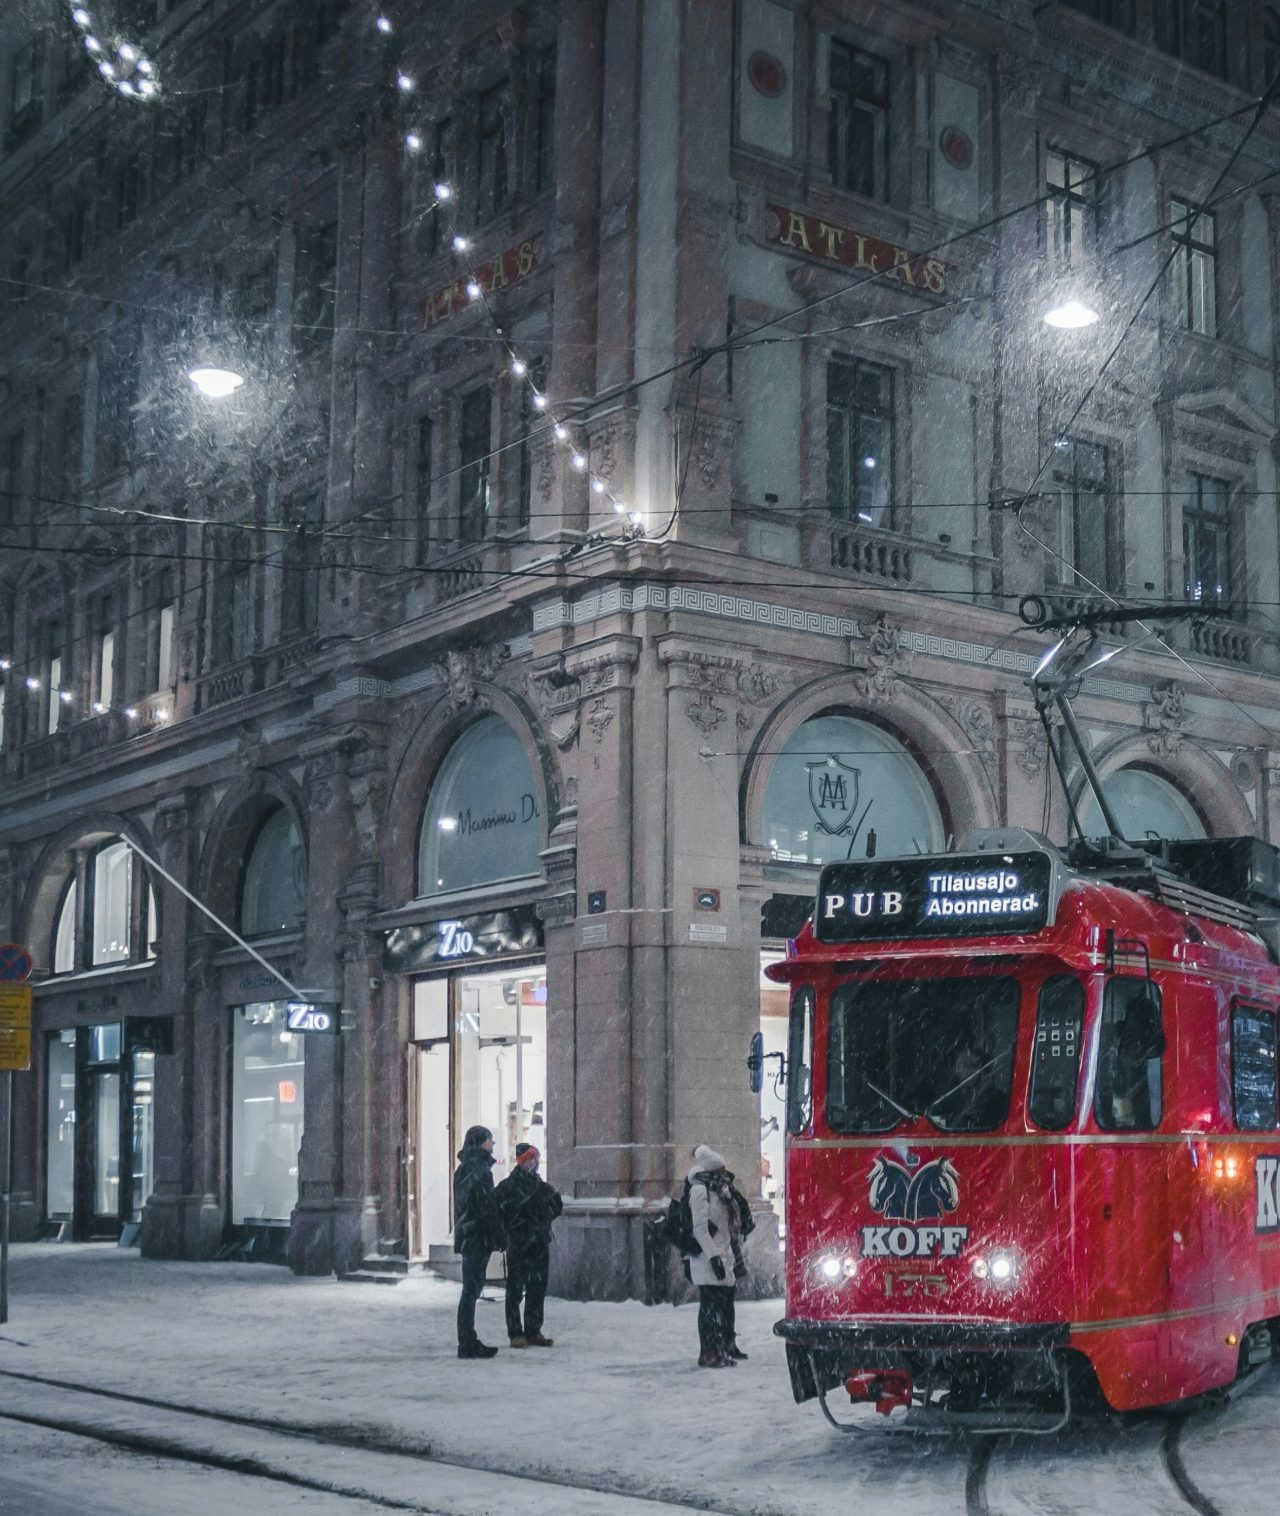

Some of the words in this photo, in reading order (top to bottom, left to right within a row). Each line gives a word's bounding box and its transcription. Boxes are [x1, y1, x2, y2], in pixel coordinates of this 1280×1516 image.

[780, 212, 945, 294] ATLAS
[423, 242, 534, 331] ATAS
[458, 808, 517, 835] Massimo
[929, 871, 1018, 893] Tilausajo
[825, 891, 902, 918] PUB
[440, 921, 473, 957] Zio
[287, 1002, 331, 1031] Zio
[861, 1226, 968, 1257] KOFF
[885, 1274, 949, 1297] 175
